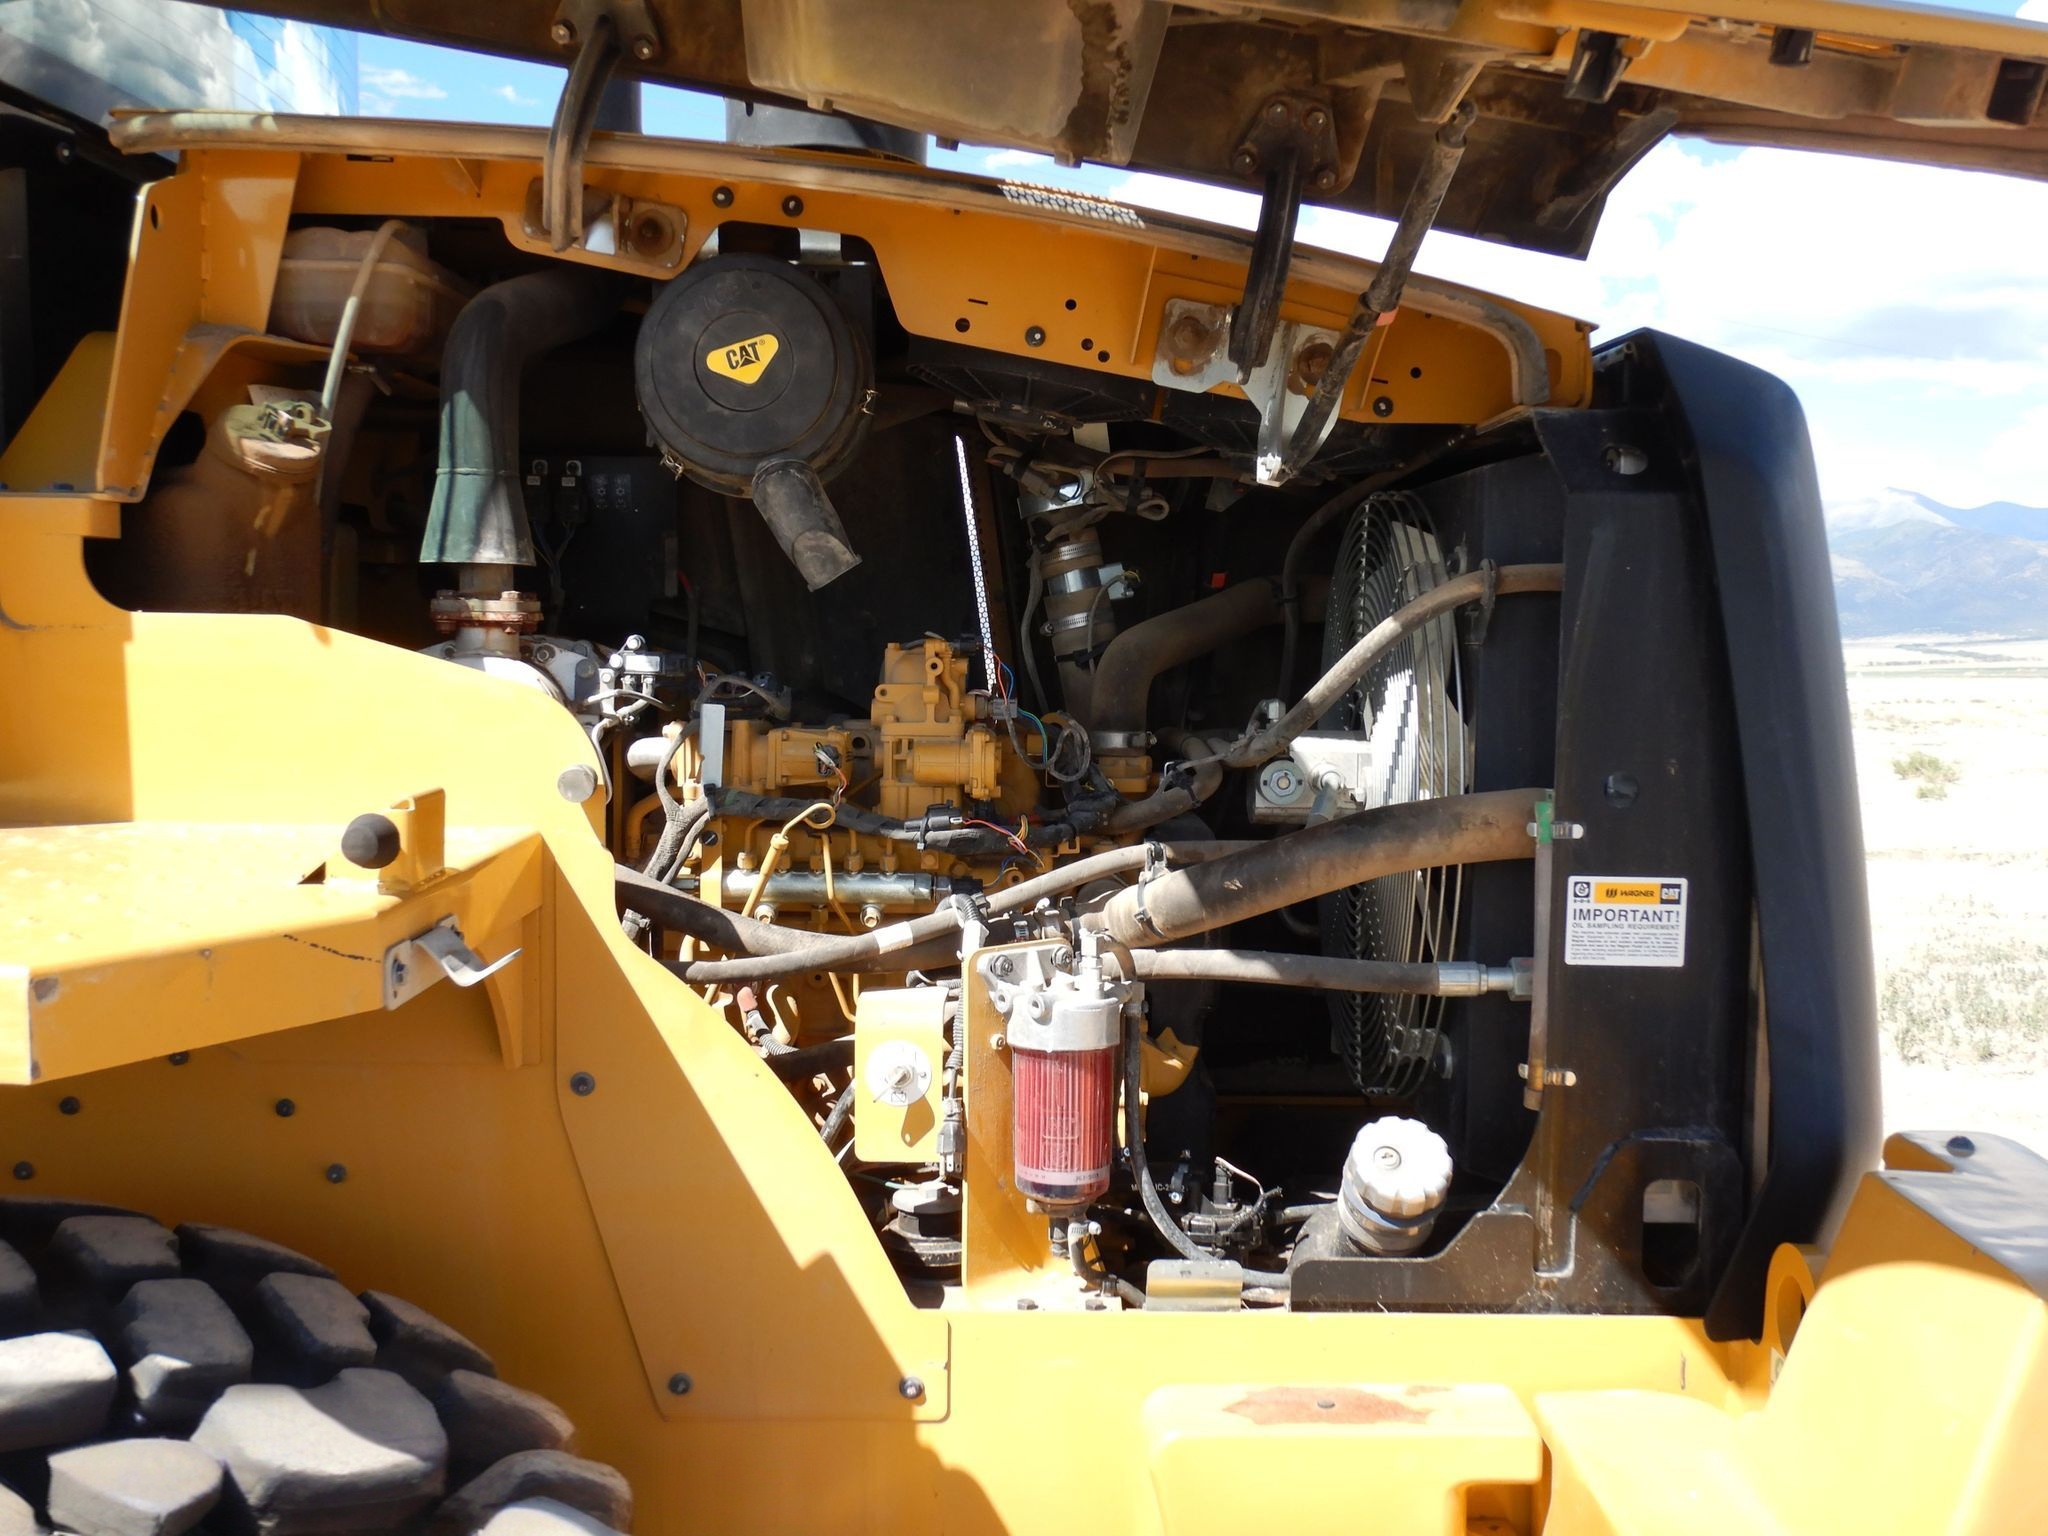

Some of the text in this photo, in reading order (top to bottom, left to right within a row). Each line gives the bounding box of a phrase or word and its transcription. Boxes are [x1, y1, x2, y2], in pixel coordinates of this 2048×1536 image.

[725, 342, 761, 370] CAT
[1620, 890, 1655, 898] WAGNER
[1661, 888, 1680, 900] CAT
[1573, 908, 1680, 923] IMPORTANT!
[1628, 923, 1680, 931] REQUIREMENT
